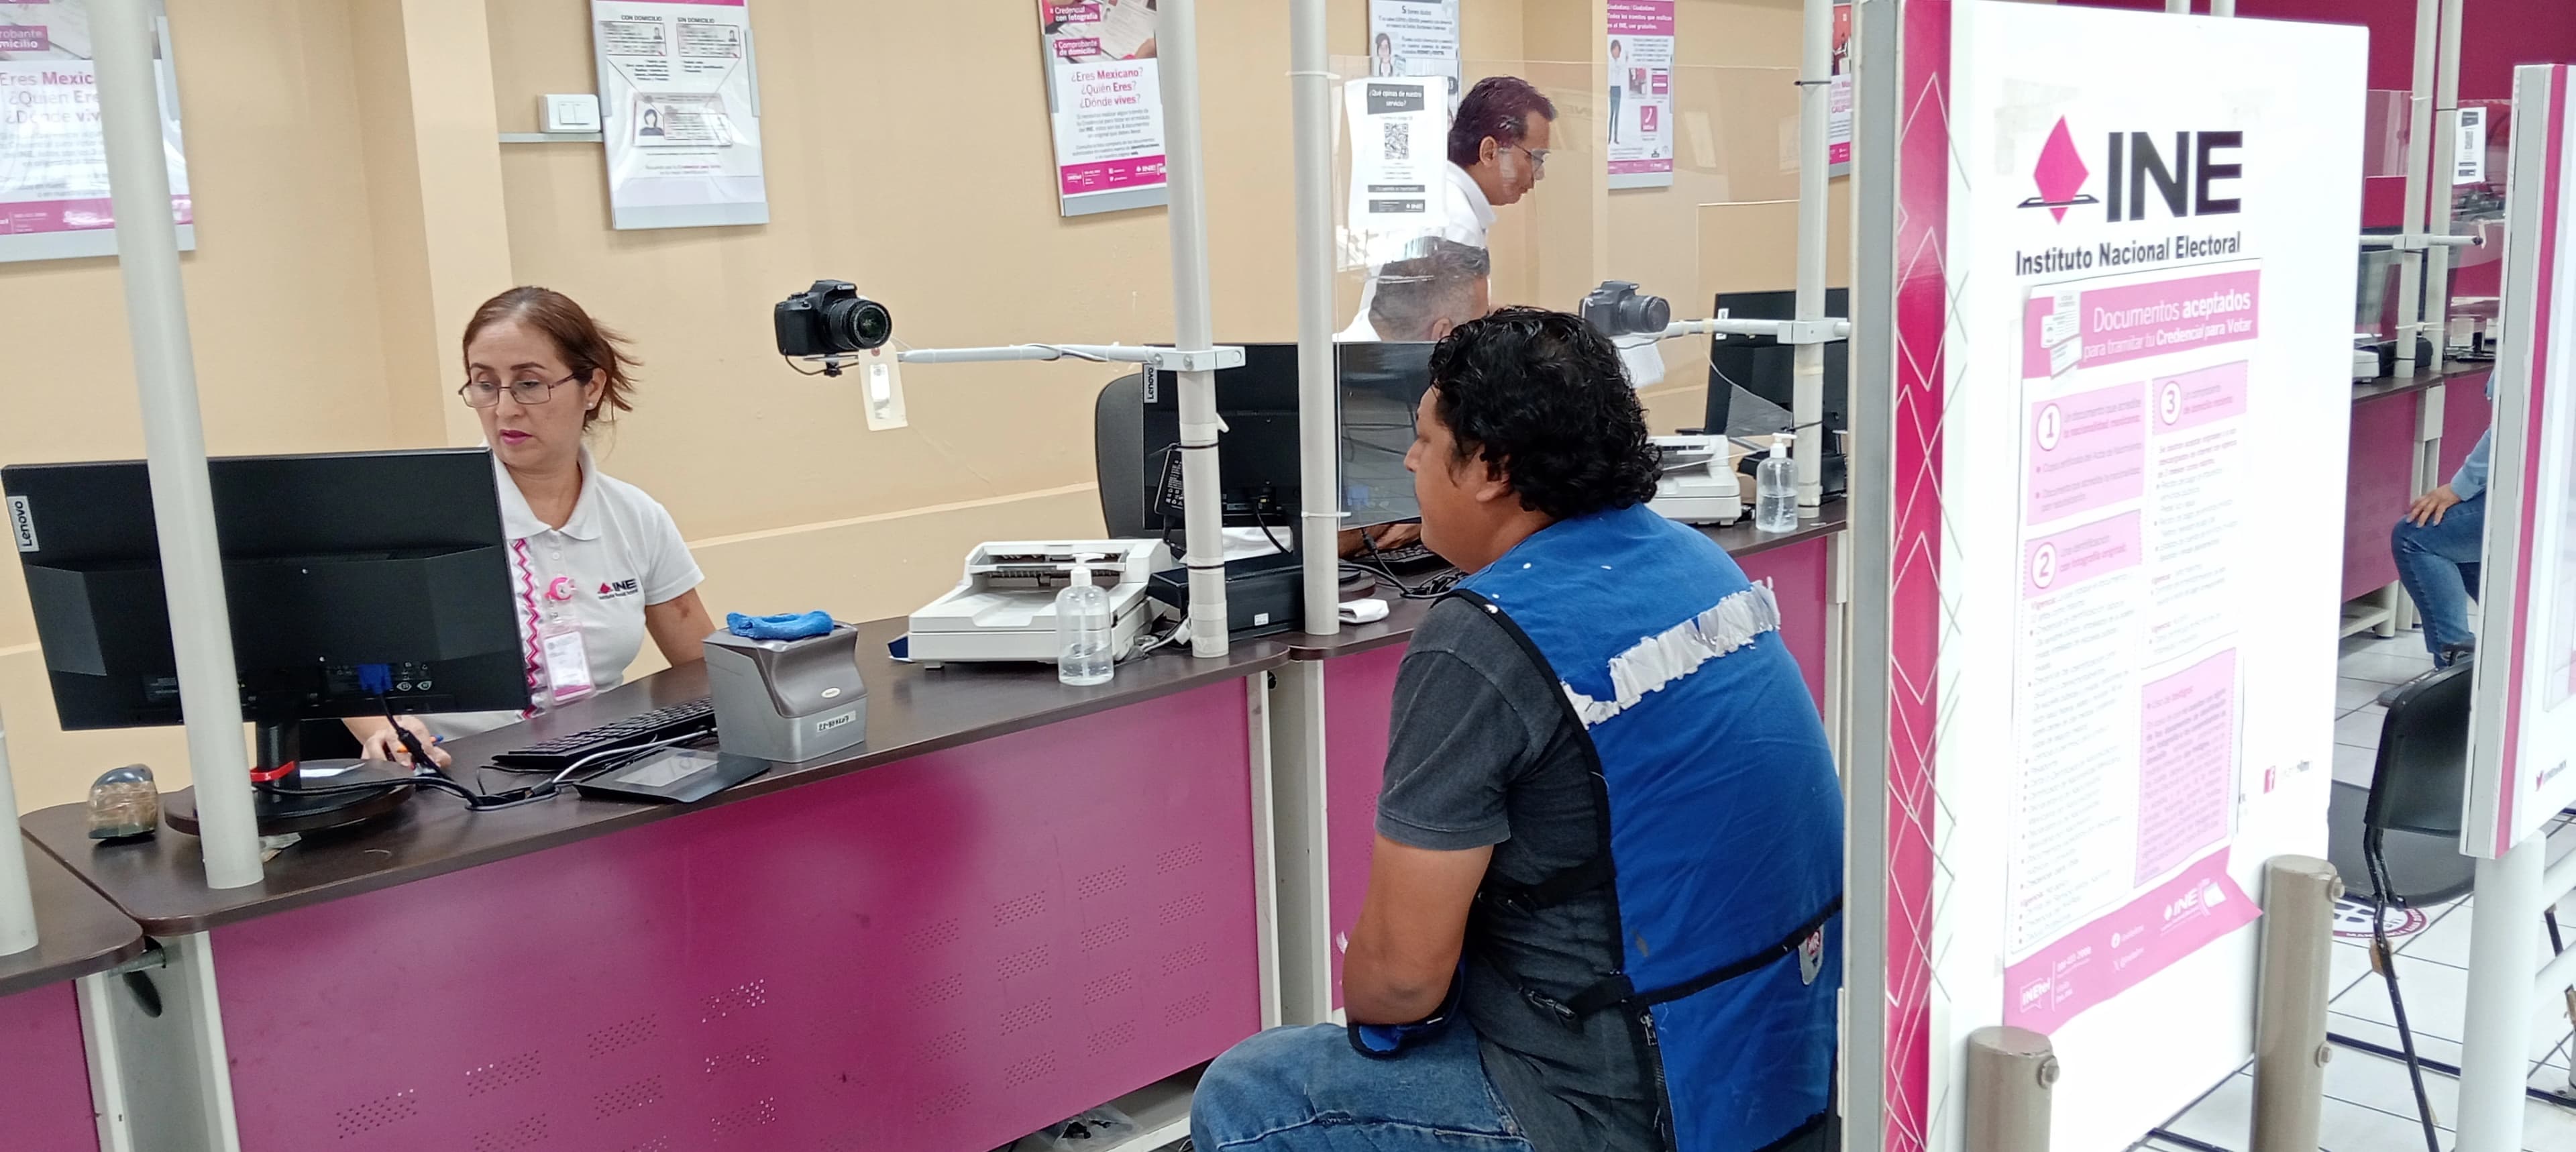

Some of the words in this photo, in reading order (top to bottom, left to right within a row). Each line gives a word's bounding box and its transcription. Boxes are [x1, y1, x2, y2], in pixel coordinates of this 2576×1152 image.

[42, 71, 93, 85] Mexic
[1071, 71, 1095, 82] ¿Eres
[1097, 66, 1143, 79] Mexicano?
[1080, 97, 1112, 109] ¿Dónde
[1114, 93, 1140, 105] vives?
[1081, 82, 1111, 96] ¿Quién
[1113, 81, 1136, 92] Eres?
[2106, 131, 2243, 222] INE
[2016, 246, 2092, 276] Instituto
[2098, 238, 2170, 267] Nacional
[2176, 231, 2241, 259] Electoral
[2093, 300, 2180, 333] Documentos
[2182, 289, 2251, 320] aceptados
[2084, 342, 2106, 362] para
[2108, 334, 2143, 354] tramitar
[2156, 325, 2204, 346] Credencial
[2203, 322, 2226, 340] para
[2226, 318, 2253, 333] Votar
[1146, 366, 1155, 400] Lenovo
[2166, 390, 2176, 414] 3
[2045, 411, 2054, 438] 1
[15, 501, 32, 547] Lenovo
[2039, 551, 2050, 578] 2
[612, 578, 637, 592] INE
[2173, 887, 2199, 916] INE
